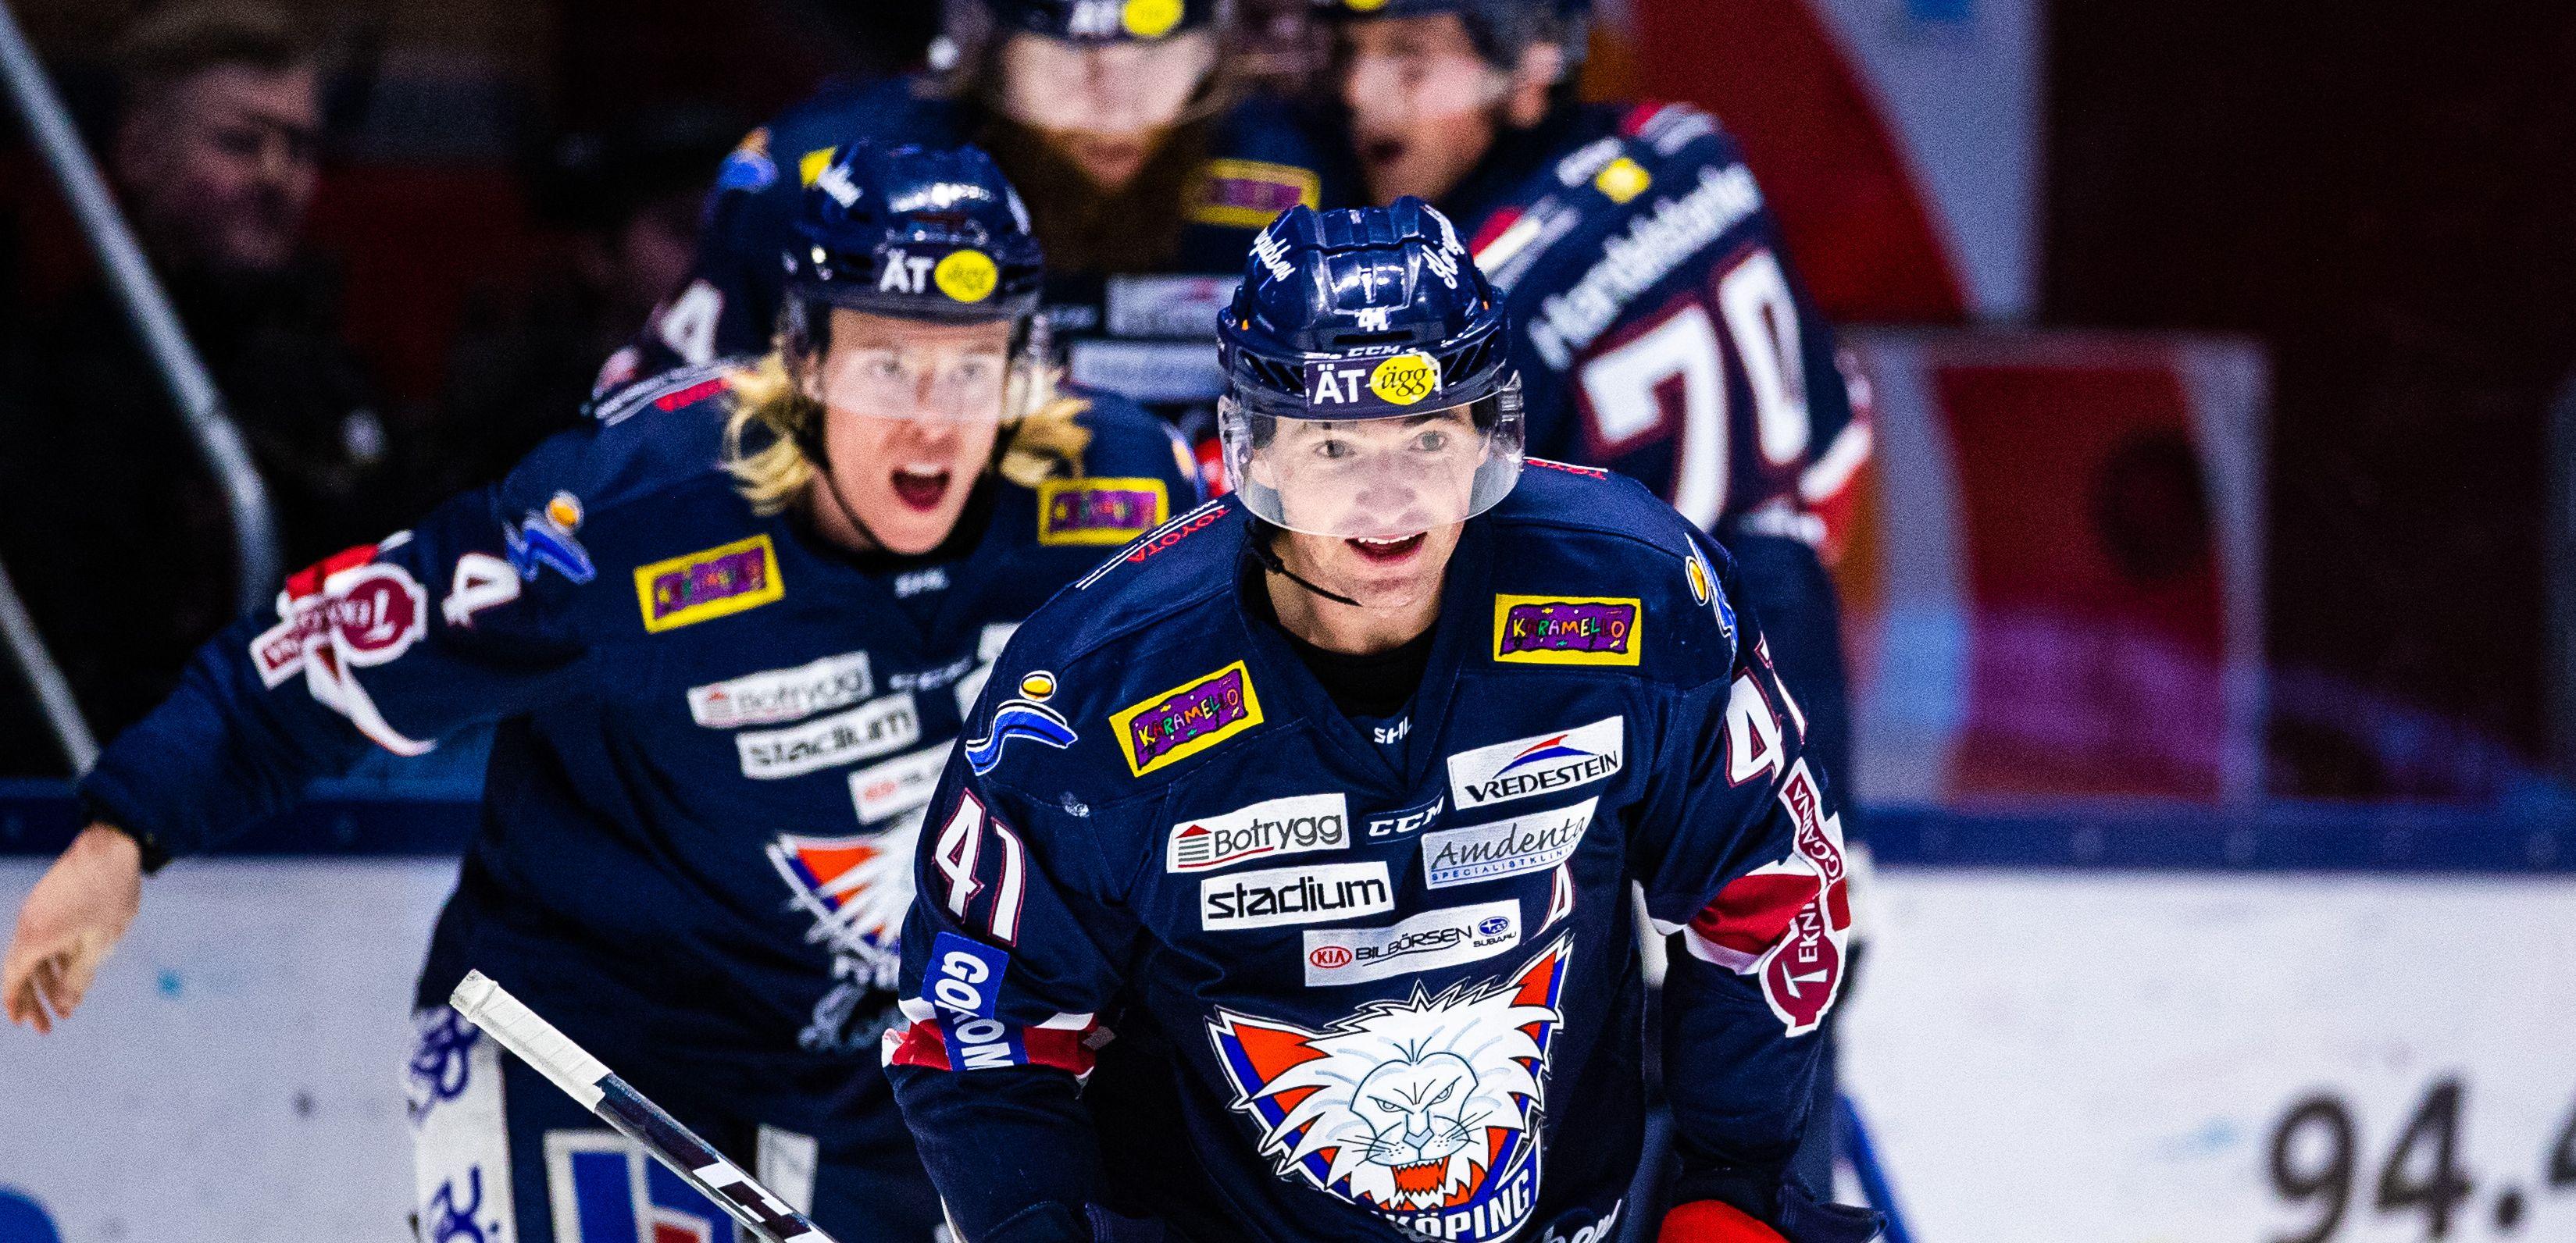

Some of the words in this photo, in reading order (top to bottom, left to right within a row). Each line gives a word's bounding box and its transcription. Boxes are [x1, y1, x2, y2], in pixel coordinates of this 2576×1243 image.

[1347, 345, 1401, 358] CCM
[1313, 363, 1366, 404] ÄT
[1381, 365, 1429, 397] ägg
[1126, 508, 1231, 564] TOYOTA
[1513, 616, 1625, 639] KARAMELLO
[1137, 688, 1240, 747] KARAMELLO
[1374, 716, 1412, 744] SHL
[1465, 750, 1618, 803] VREDESTEIN
[1214, 814, 1342, 858] Botrygg
[1368, 795, 1445, 838] CCM
[1431, 816, 1586, 870] Amdenta
[932, 787, 1026, 948] 41
[1207, 875, 1387, 920] stadium
[1316, 949, 1347, 965] KIA
[1355, 925, 1472, 961] BILBÖRSEN
[1472, 931, 1517, 948] SUBARU
